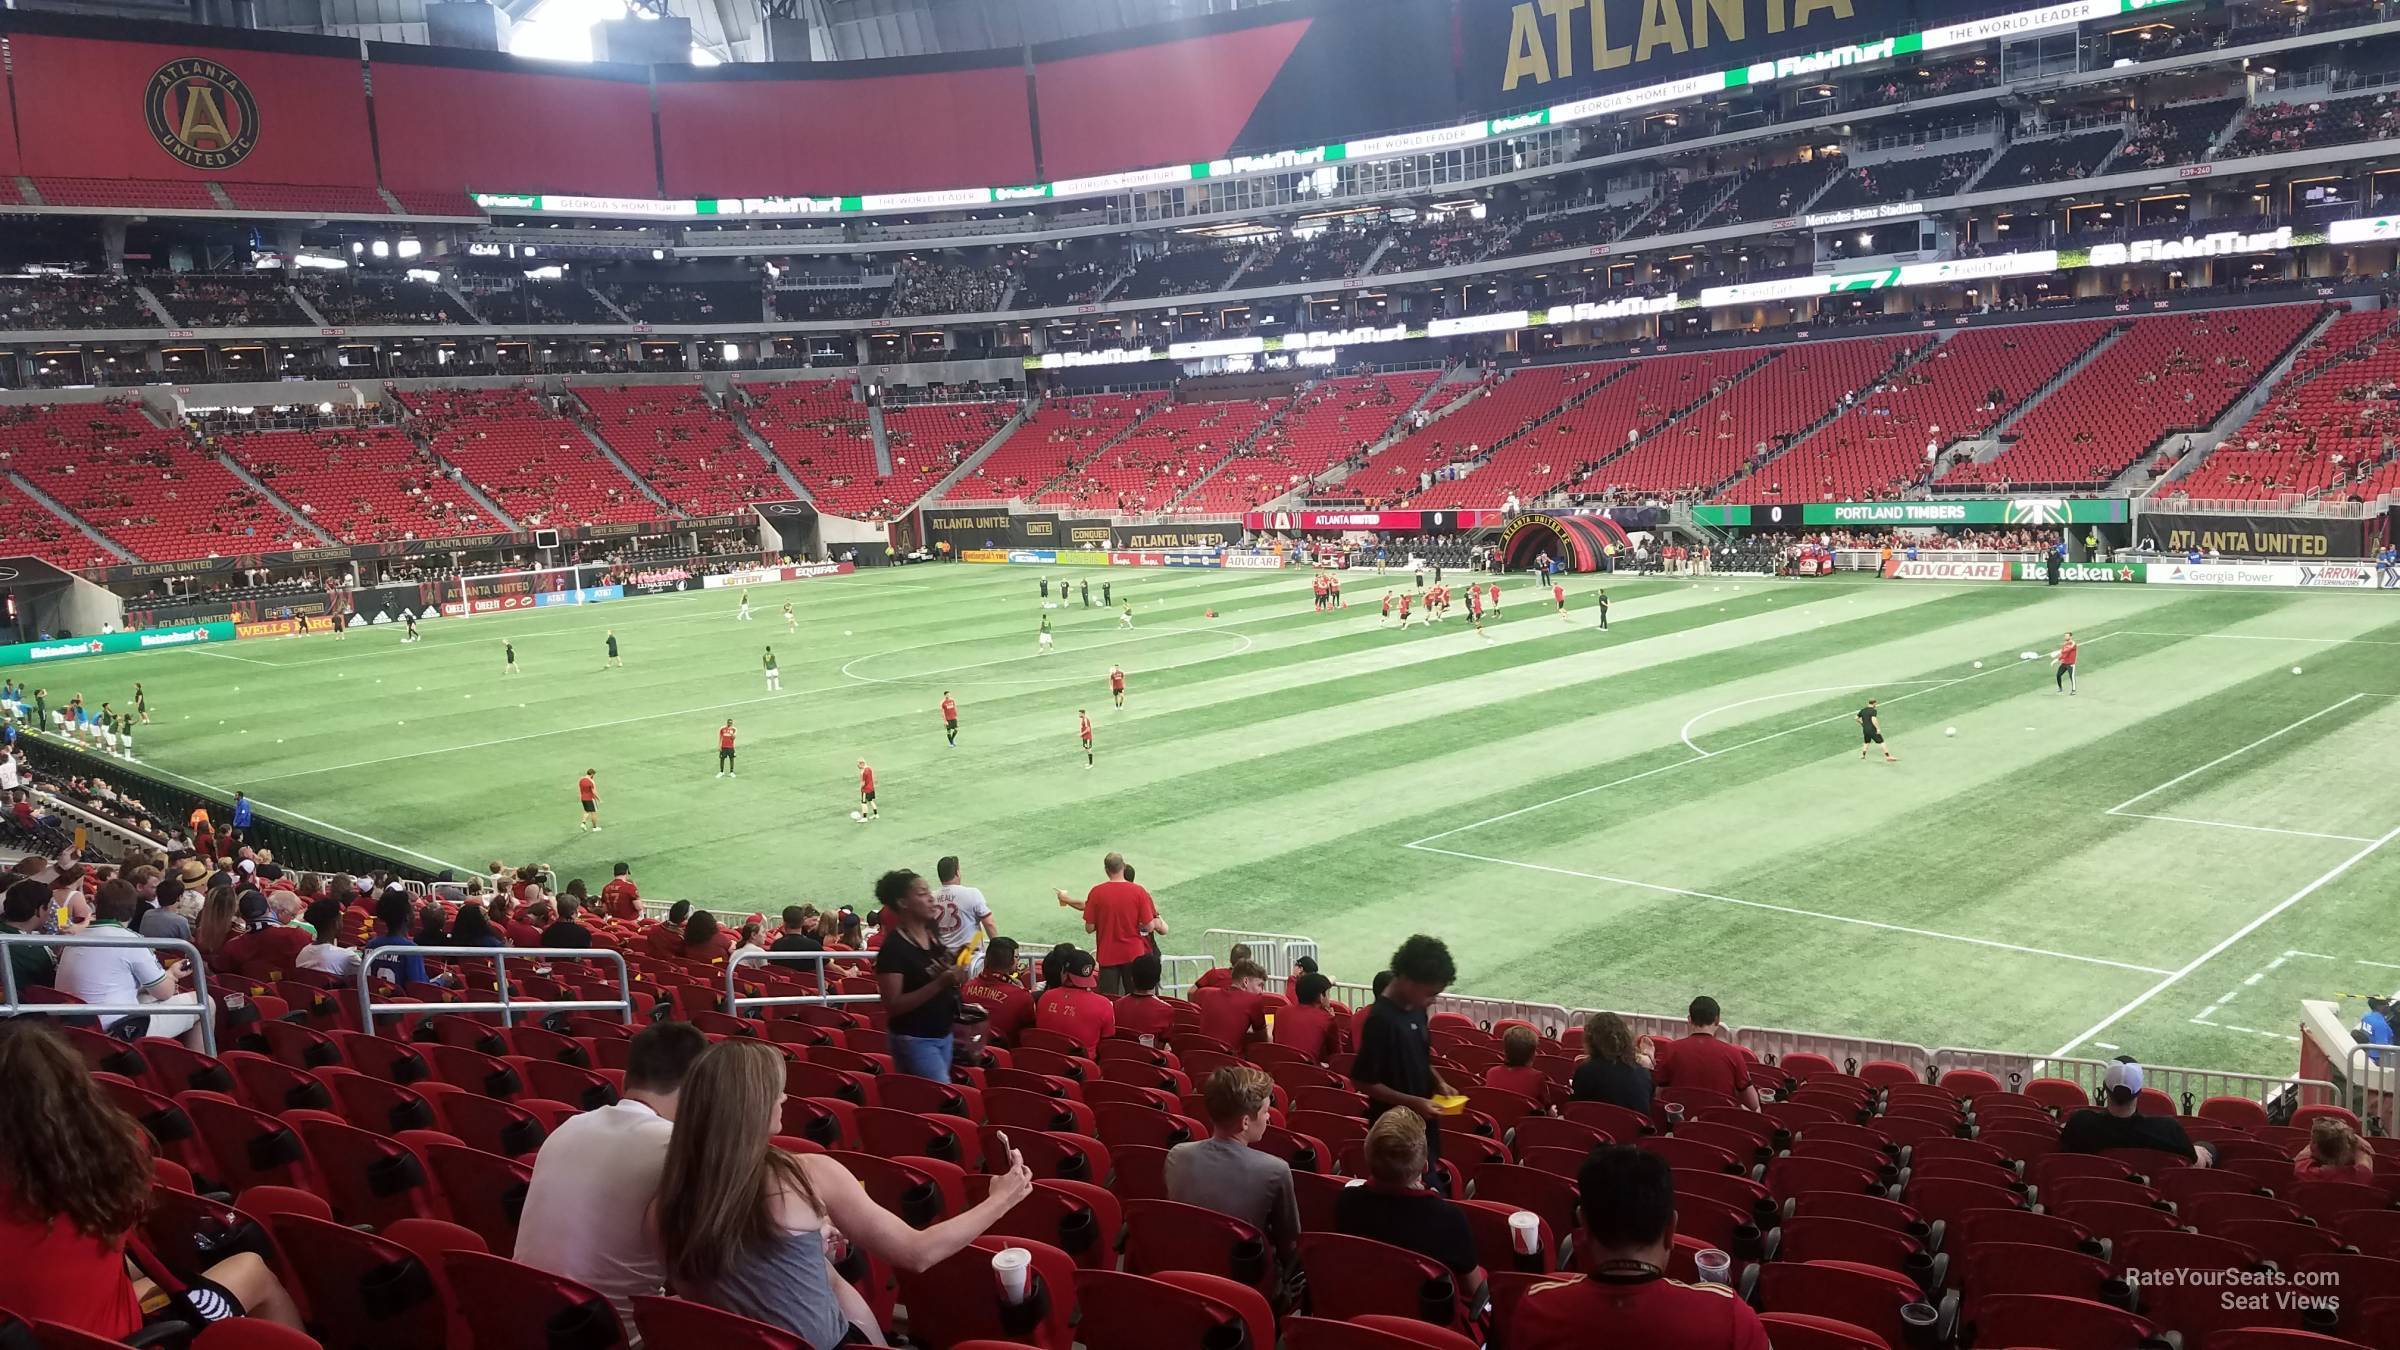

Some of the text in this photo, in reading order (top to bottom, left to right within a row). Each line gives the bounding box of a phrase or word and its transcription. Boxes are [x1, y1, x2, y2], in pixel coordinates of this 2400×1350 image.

[1950, 5, 2090, 41] THE WORLD LEADER
[1777, 37, 1896, 79] FieldTurf
[159, 61, 238, 90] ATLANTA
[1636, 88, 1670, 102] HOME
[1672, 81, 1698, 94] TURF
[1363, 129, 1466, 152] THE WORLD LEADER
[162, 134, 250, 165] UNITED FC
[2181, 166, 2210, 177] 239-240
[1805, 209, 1878, 228] Mercedes-Benz
[1880, 201, 1922, 218] Stadium
[1315, 516, 1349, 525] ATLANTA
[1350, 515, 1380, 525] UNITED
[1434, 513, 1442, 525] 0
[1772, 505, 1966, 522] 0 PORTLAND TIMBERS
[676, 517, 733, 530] ATLANTA UNITED
[932, 516, 974, 530] ATLANTA
[1029, 523, 1051, 534] UNITE
[1503, 515, 1531, 541] ATLANTA
[1534, 515, 1561, 533] UNITED
[592, 527, 606, 536] UNITE
[1074, 529, 1109, 541] CONQUER
[425, 536, 493, 549] ATLANTA UNITED
[1131, 534, 1178, 548] ATLANTA
[2253, 532, 2328, 557] UNITED
[294, 551, 313, 560] UNITE
[320, 549, 349, 559] CONQUER
[1227, 556, 1281, 567] ADVOCARE
[131, 559, 212, 576] ATLANTA UNITED
[796, 564, 841, 577] EQUIFAX
[1899, 563, 2000, 579] ADVOCARE
[2021, 562, 2114, 582] Heneken
[2317, 567, 2361, 579] ARROW
[722, 574, 763, 587] LOTTERY
[2189, 570, 2273, 584] Georgia Power
[2313, 578, 2360, 587] EXTERMINATORS
[493, 582, 530, 594] UNITED
[637, 581, 673, 590] LUNAZUL
[546, 593, 566, 603] AT&T
[594, 588, 613, 598] AT&T
[158, 613, 230, 629] ATLANTA UNITED
[238, 622, 290, 638] WELLS
[140, 631, 196, 647] Heineken
[29, 642, 89, 659] Heineken
[934, 903, 962, 932] 23
[966, 985, 1008, 1003] MARTINEZ
[1048, 1002, 1058, 1013] EL
